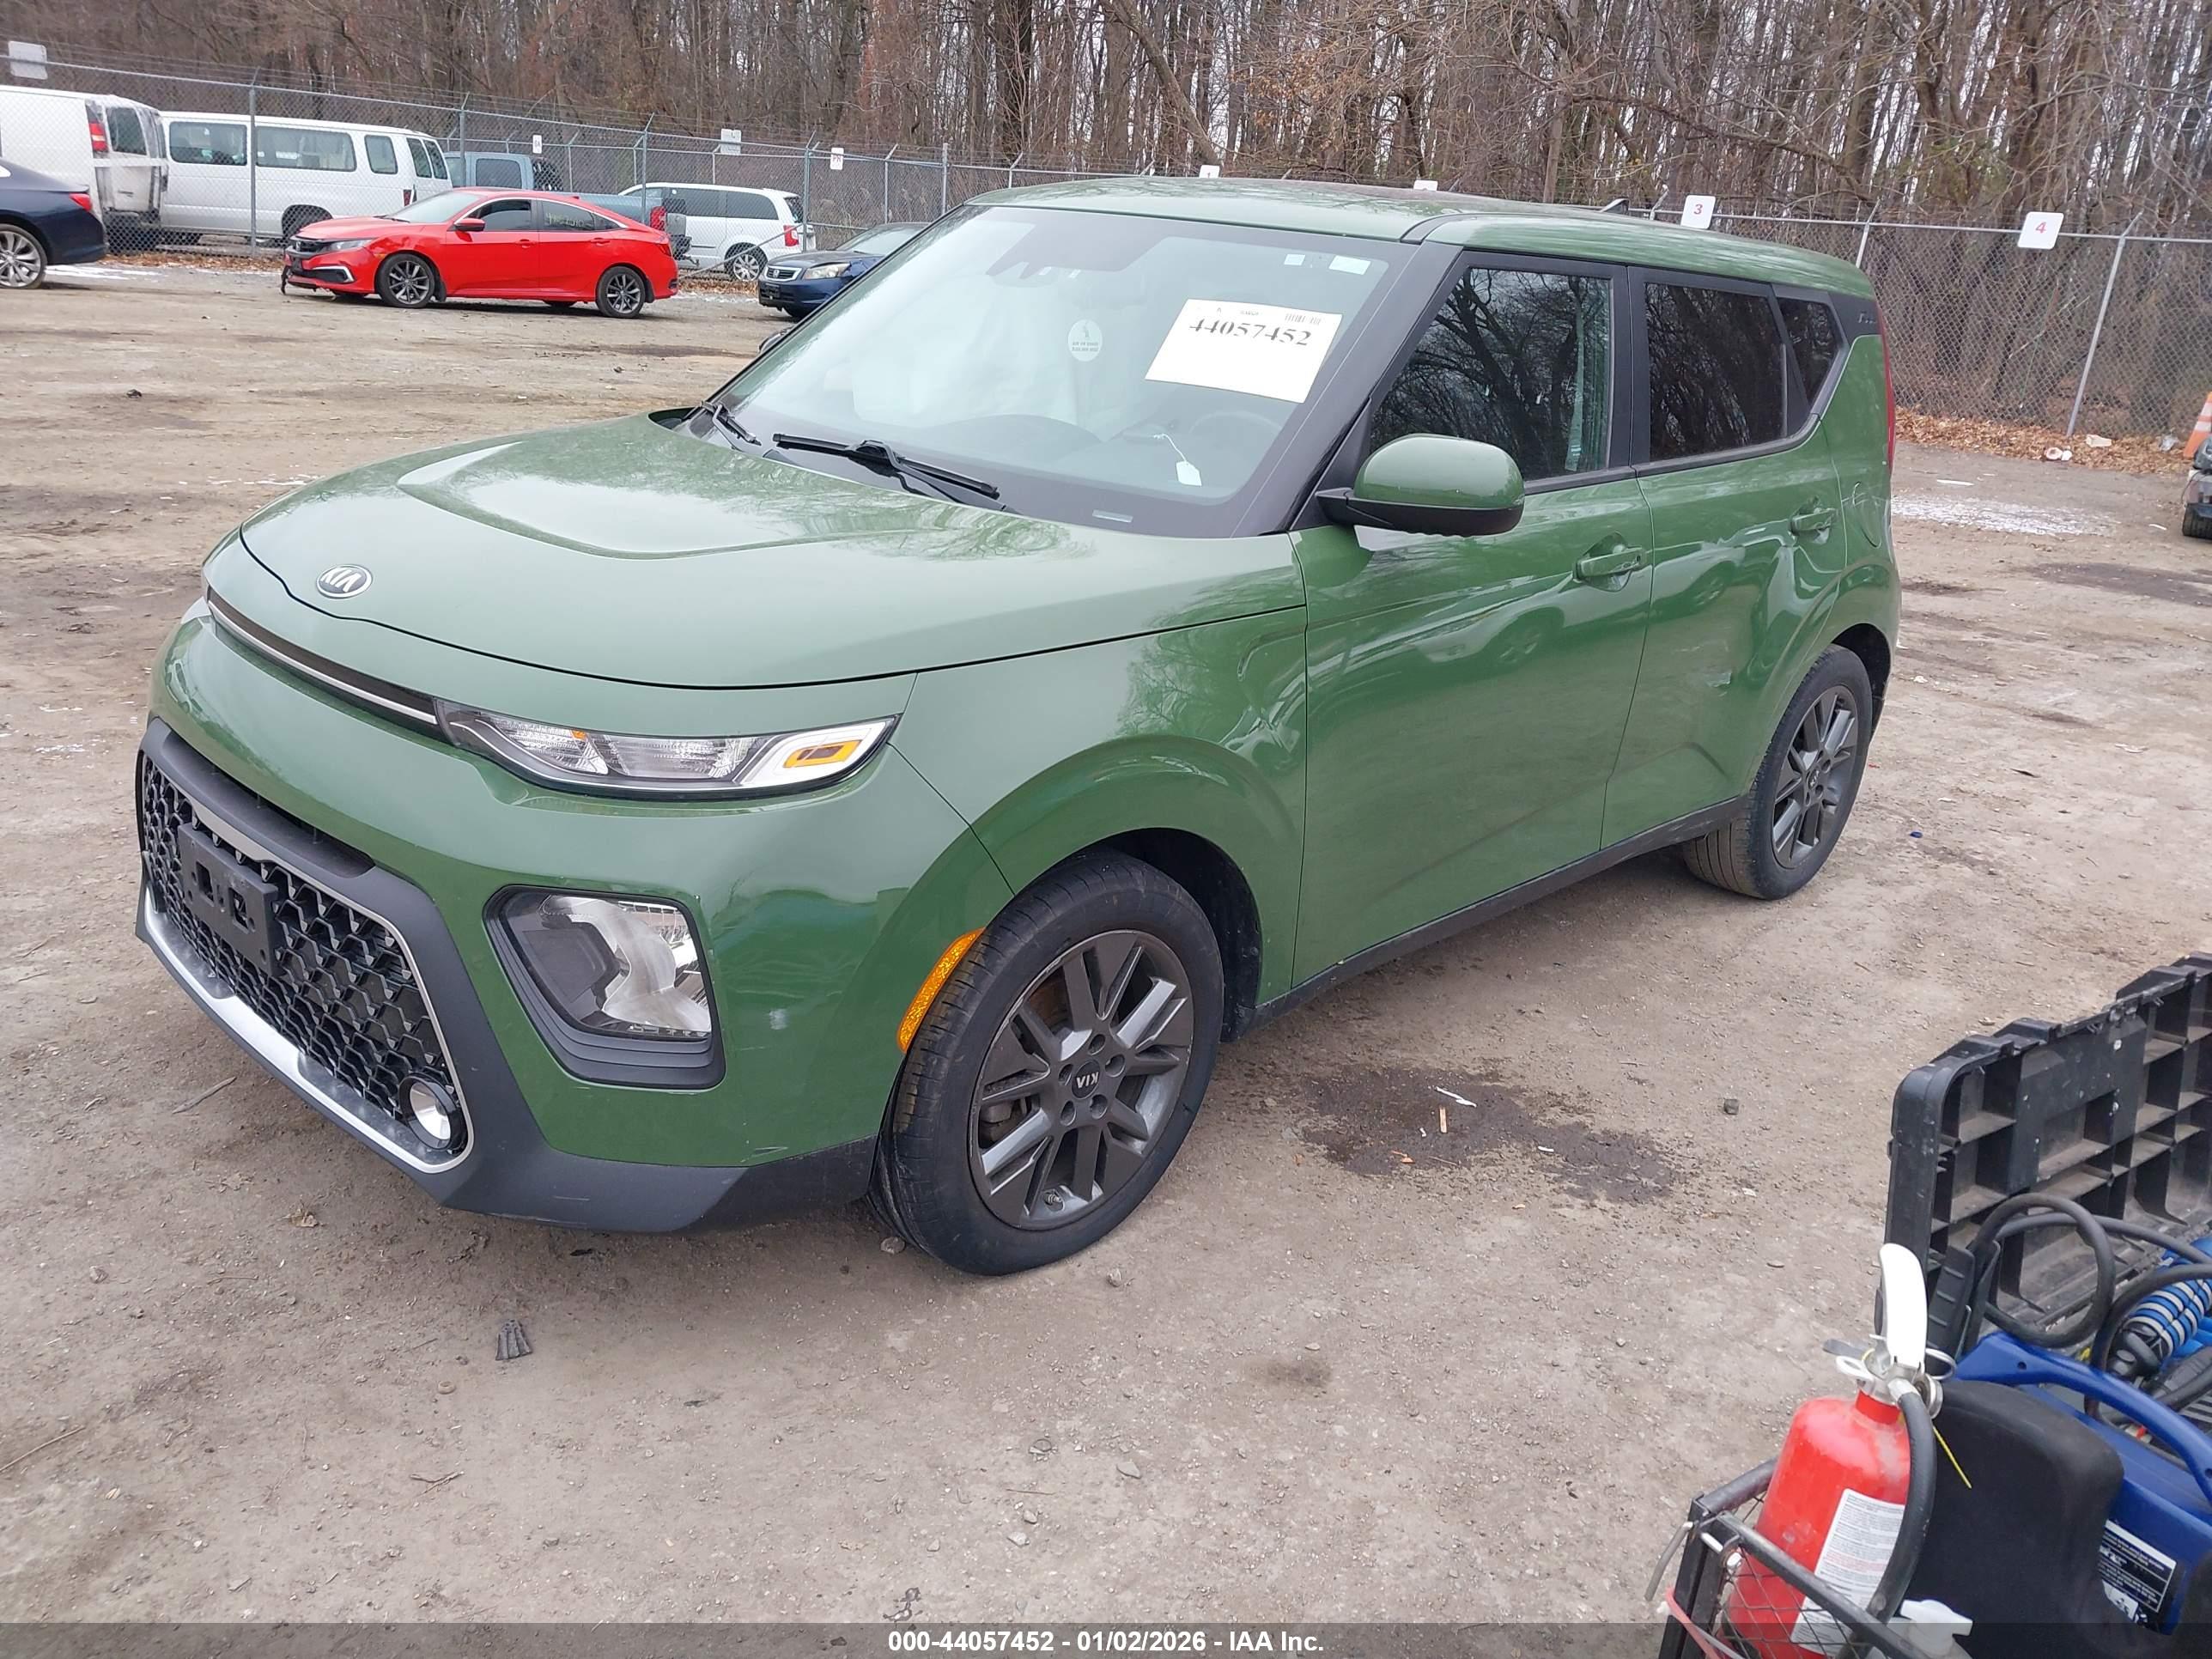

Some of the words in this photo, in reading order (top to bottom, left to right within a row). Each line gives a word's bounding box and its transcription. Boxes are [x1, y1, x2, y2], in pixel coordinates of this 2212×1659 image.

[1693, 204, 1704, 215] 3
[2035, 222, 2047, 234] 4
[1188, 318, 1312, 346] 44057452
[319, 567, 362, 592] KIA
[1076, 1071, 1099, 1089] KIA
